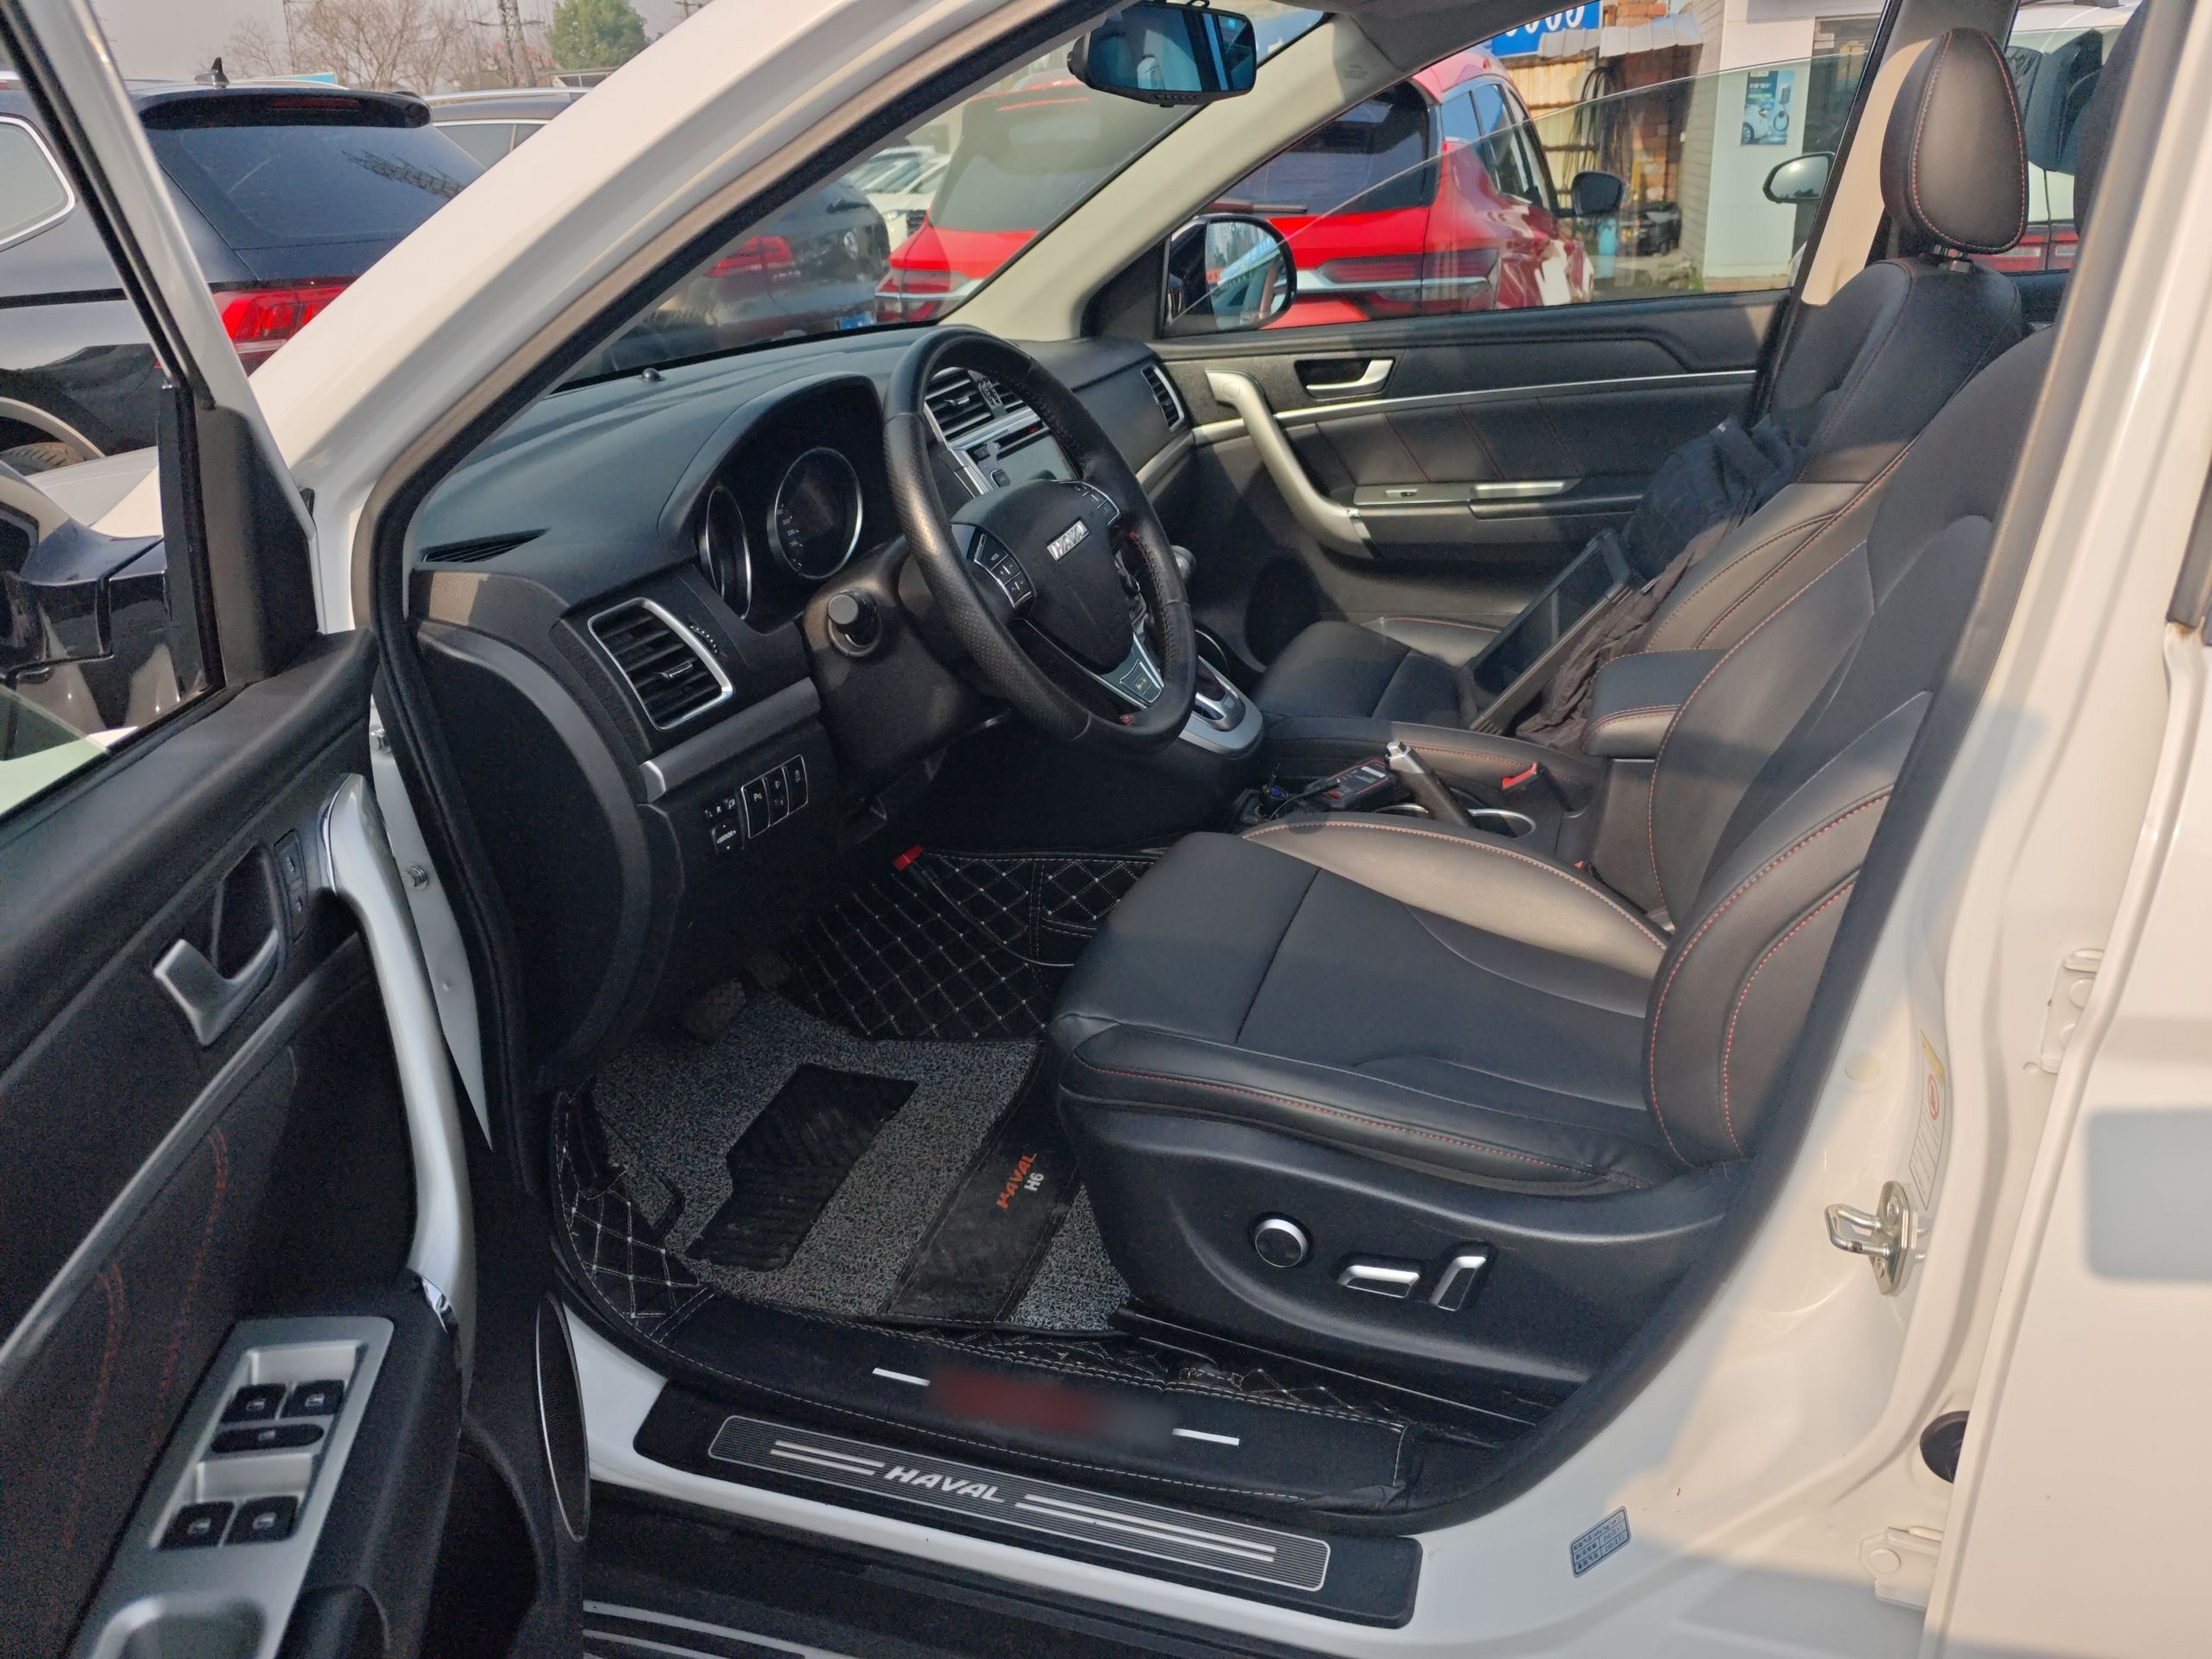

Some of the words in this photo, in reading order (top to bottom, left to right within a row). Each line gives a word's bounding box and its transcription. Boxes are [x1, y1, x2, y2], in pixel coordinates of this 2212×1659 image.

[996, 1153, 1037, 1209] HAVAL
[1024, 1172, 1044, 1191] H6
[884, 1465, 1005, 1503] HAVAL
